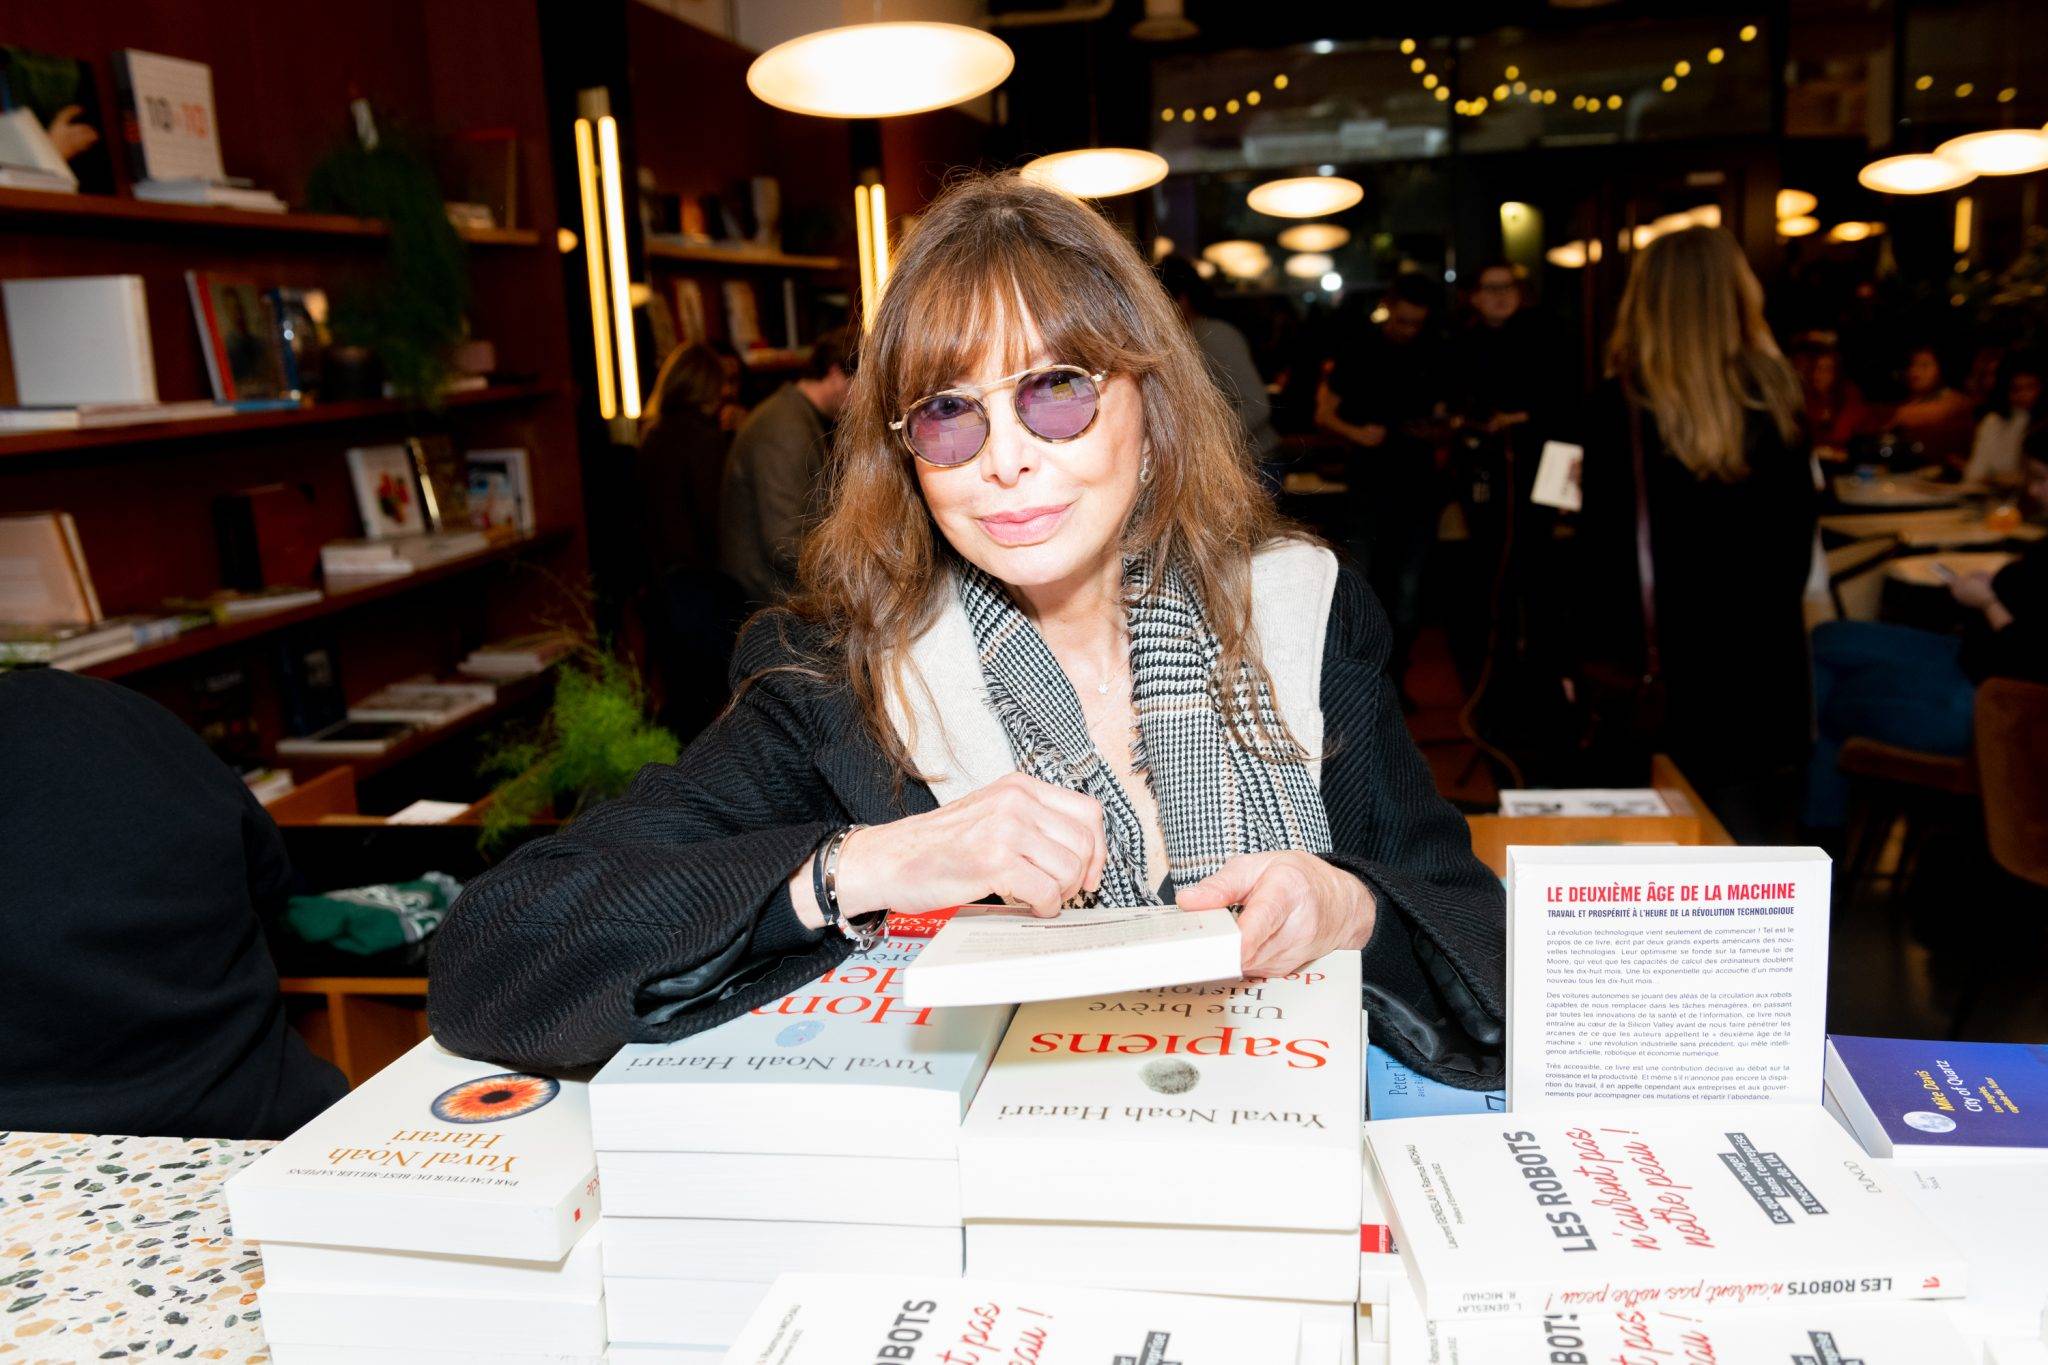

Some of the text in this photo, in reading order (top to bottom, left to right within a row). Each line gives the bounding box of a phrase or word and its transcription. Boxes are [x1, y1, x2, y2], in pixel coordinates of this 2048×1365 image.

[1547, 880, 1795, 902] LE DEUXIÈME ÂGE DE LA MACHINE
[1548, 905, 1794, 918] TRAVAIL ET PROSPÉRITÉ À L'HEURE DE LA RÉVOLUTION TECHNOLOGIQUE
[751, 995, 933, 1027] Hom
[1088, 1001, 1285, 1020] Une brève
[1030, 1027, 1329, 1069] Sapiens
[625, 1056, 934, 1075] Yuval Noah Harari
[1388, 1072, 1408, 1096] Peter
[1914, 1070, 1955, 1111] Mike Davis
[1936, 1060, 1983, 1112] City of Quartz
[998, 1104, 1326, 1129] Yuval Noah Harari
[386, 1130, 503, 1150] Harari
[286, 1168, 335, 1177] SAPIENS
[328, 1148, 519, 1173] Yuval Noah
[1621, 1141, 1692, 1188] peau
[1734, 1134, 1786, 1196] dans l'entreprise
[1764, 1154, 1785, 1168] l'IA
[1776, 1168, 1792, 1178] de
[337, 1170, 410, 1181] BEST-SELLER
[413, 1173, 432, 1182] DU
[494, 1178, 519, 1187] PAR
[1725, 1154, 1788, 1223] Ce qui va changer
[1844, 1160, 1882, 1193] DUNOD
[1502, 1130, 1597, 1253] LES ROBOTS
[1565, 1128, 1661, 1250] n'auront pas
[1787, 1178, 1816, 1206] l'heure
[1651, 1192, 1715, 1248] notre
[1440, 1225, 1459, 1249] Laurent
[1545, 1277, 1892, 1310] LES ROBOTS n'auront pas notre peau !
[958, 1303, 1001, 1352] pas
[1615, 1311, 1672, 1354] pas
